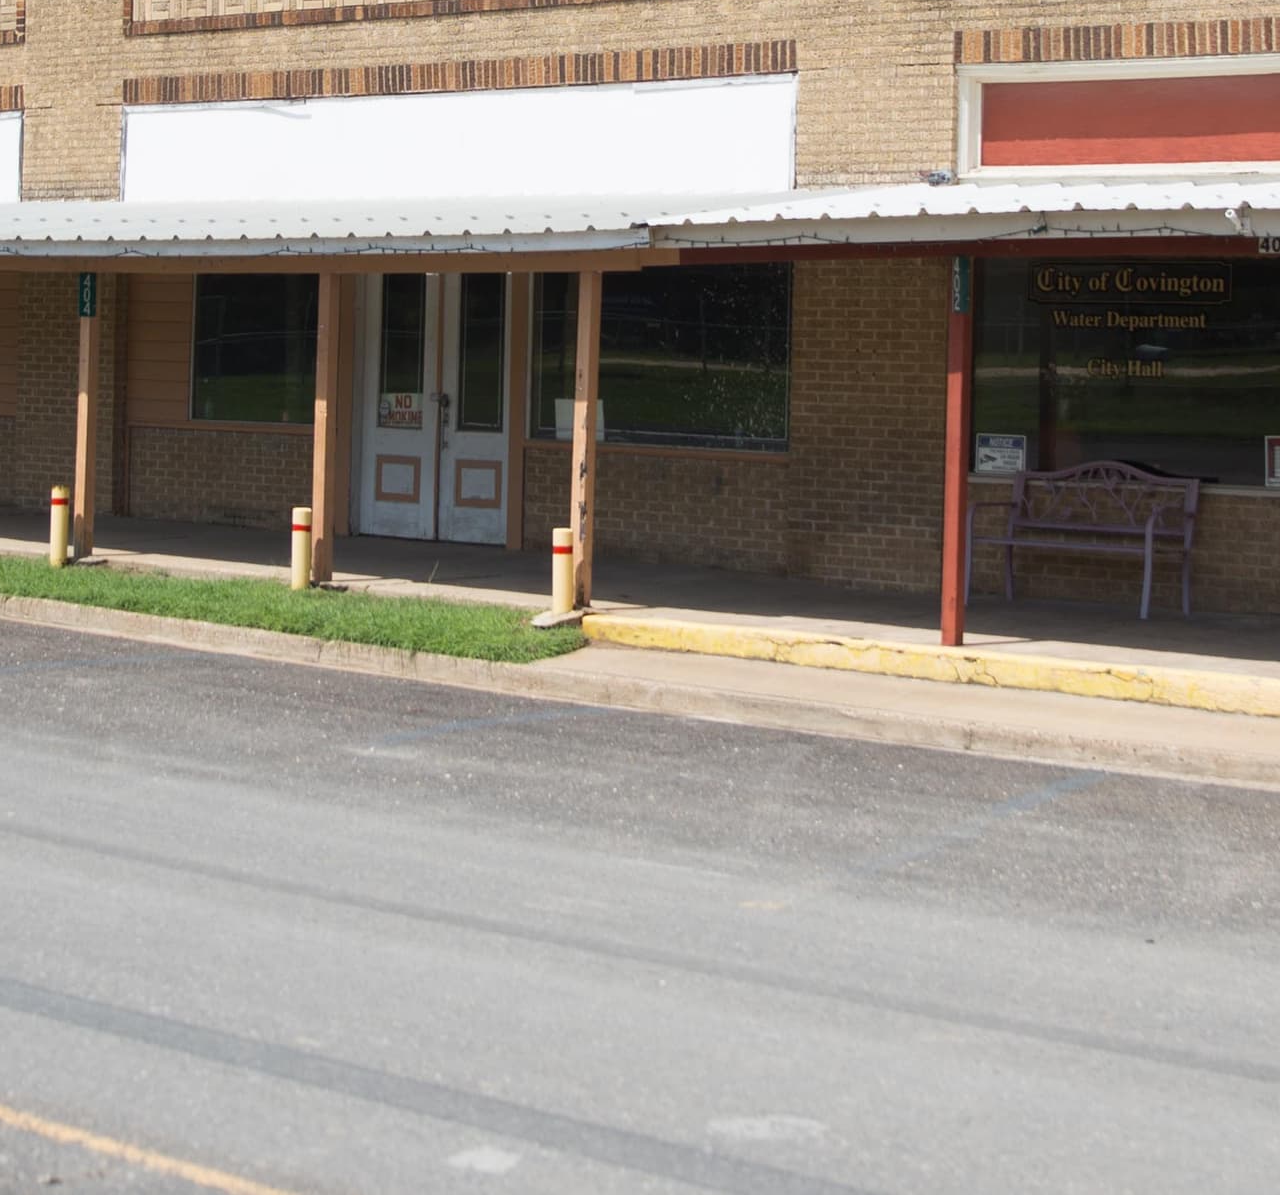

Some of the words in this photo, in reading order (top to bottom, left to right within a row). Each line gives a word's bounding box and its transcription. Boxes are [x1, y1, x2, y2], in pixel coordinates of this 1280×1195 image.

[1036, 267, 1082, 296] City
[1088, 270, 1110, 292] of
[1115, 267, 1225, 296] Covington
[83, 274, 91, 316] 404
[1053, 310, 1102, 327] Water
[1107, 311, 1207, 331] Department
[1087, 359, 1120, 379] City
[1127, 360, 1163, 377] Hall
[395, 395, 412, 409] NO
